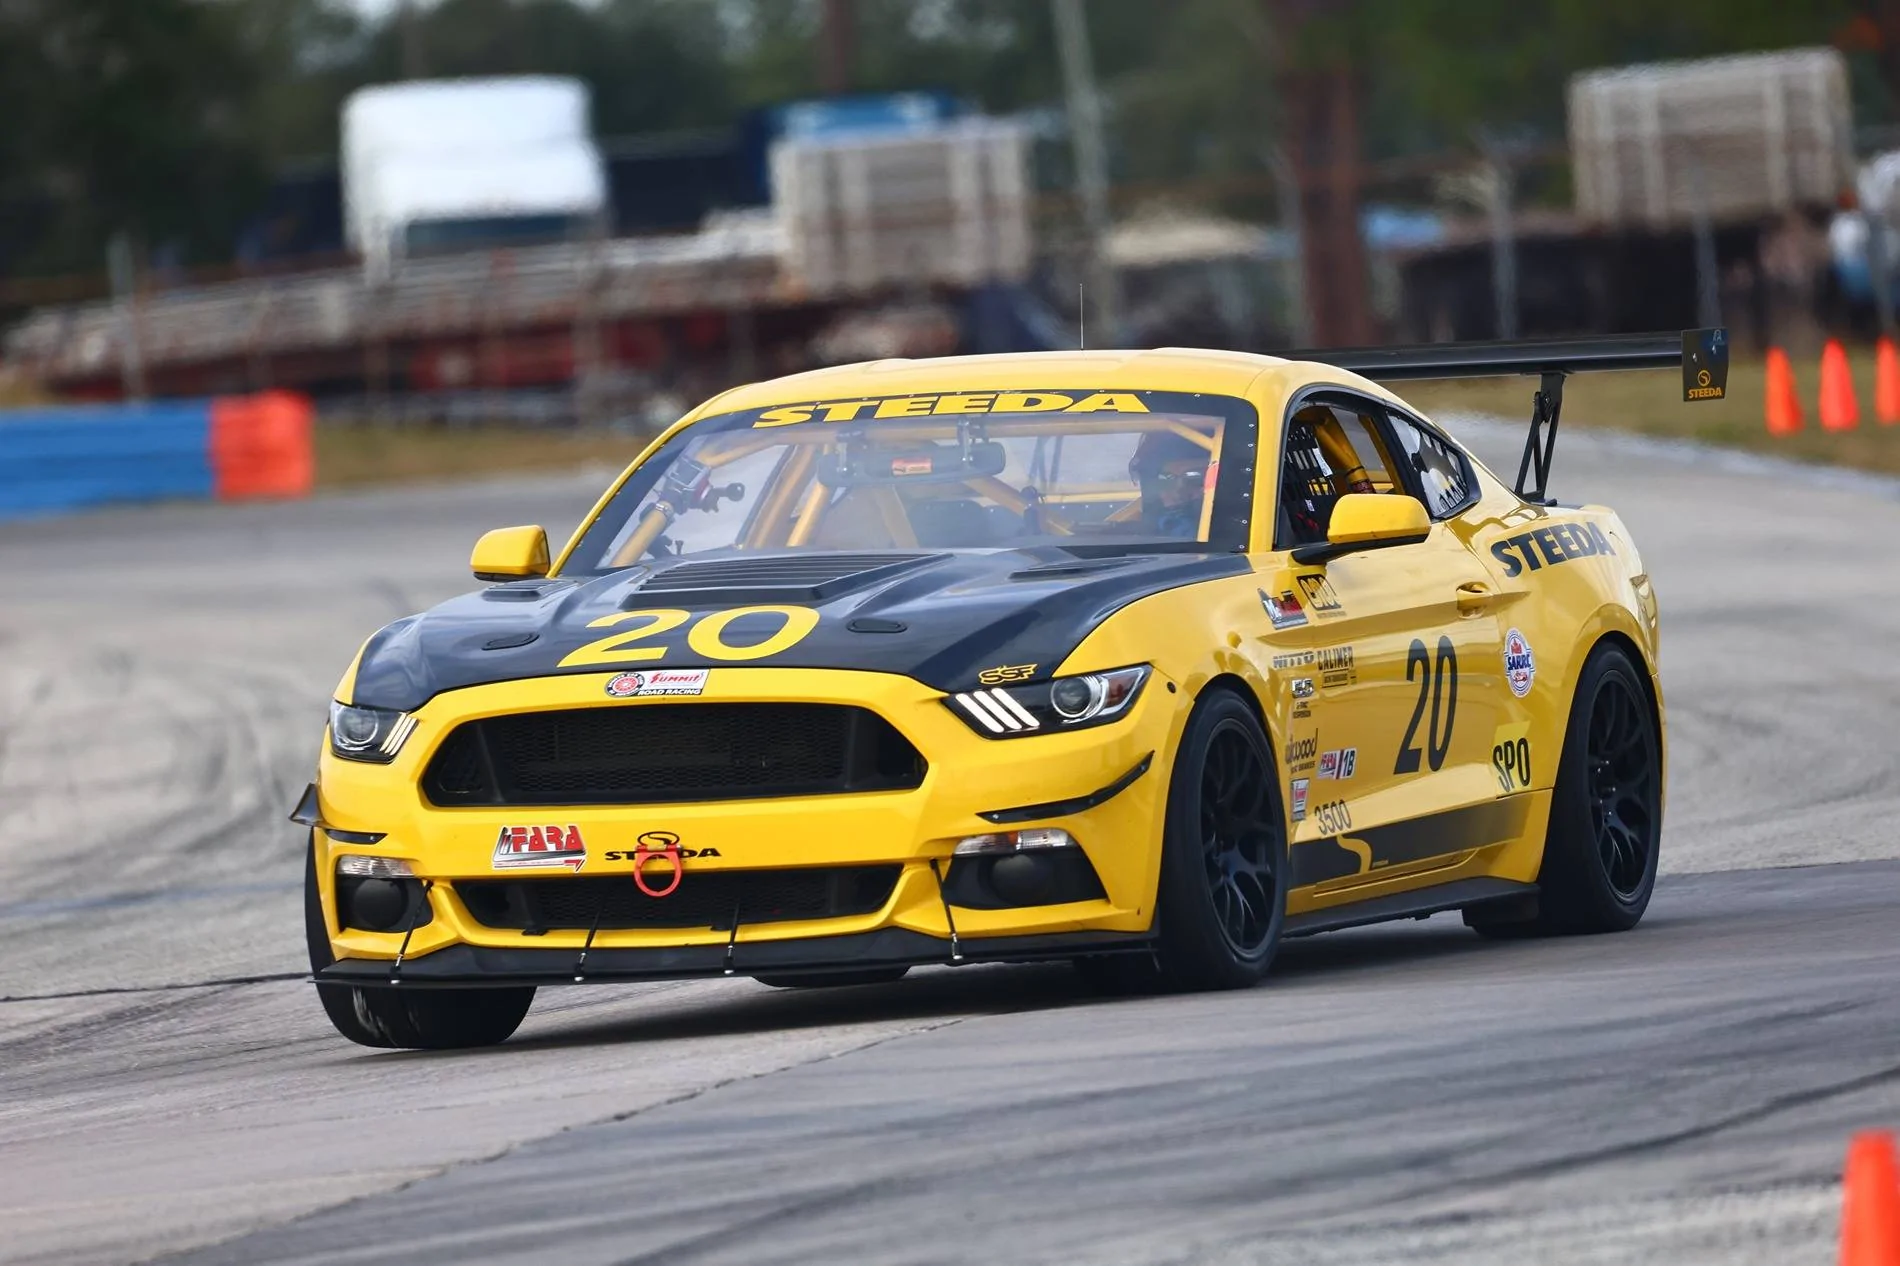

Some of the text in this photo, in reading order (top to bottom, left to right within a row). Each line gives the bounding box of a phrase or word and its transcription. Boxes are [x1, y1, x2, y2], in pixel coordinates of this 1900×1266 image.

[752, 393, 1150, 428] STEEDA
[1688, 387, 1722, 398] STEEDA
[1490, 521, 1616, 578] STEEDA
[556, 605, 821, 668] 20
[1393, 635, 1458, 775] 20
[1492, 738, 1531, 793] SPO
[1314, 799, 1352, 835] 3500
[511, 826, 584, 852] FARA
[605, 848, 722, 861] STDA
